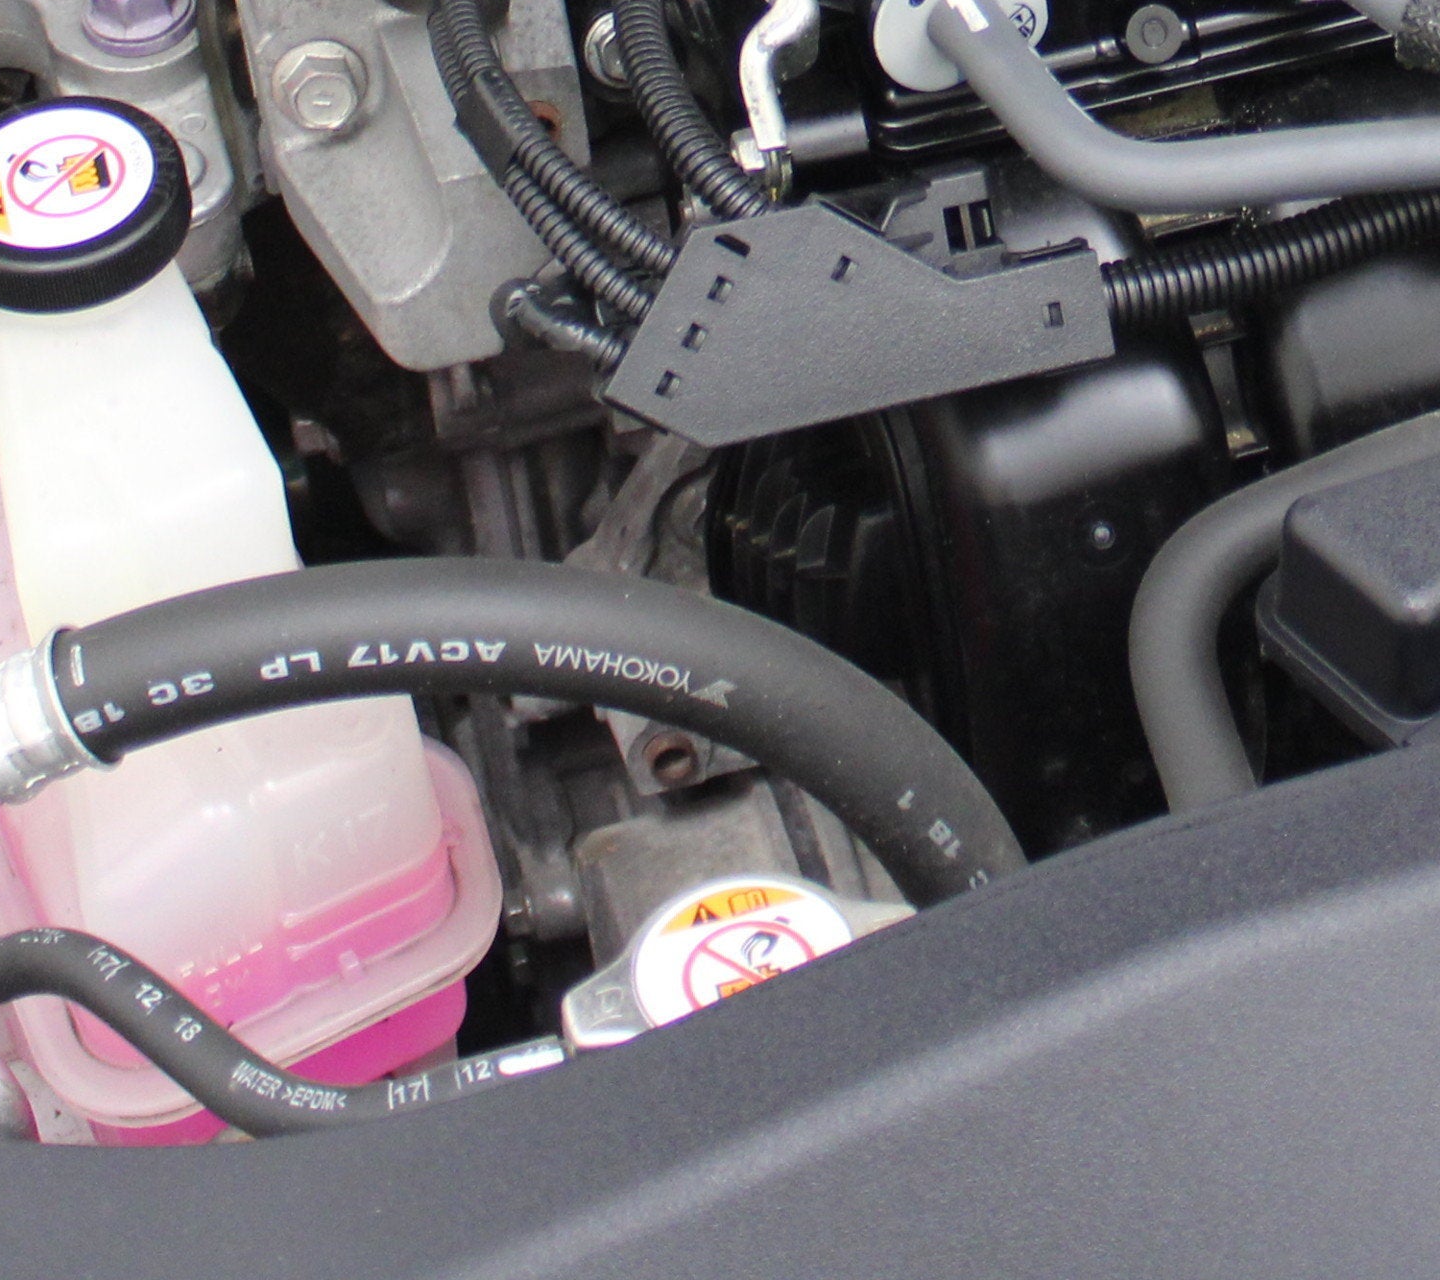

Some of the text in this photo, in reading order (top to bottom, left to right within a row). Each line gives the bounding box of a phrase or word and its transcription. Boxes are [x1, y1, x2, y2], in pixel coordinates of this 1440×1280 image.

[260, 648, 322, 681] LP
[347, 639, 507, 669] ACV17
[534, 642, 691, 693] YOKOHAMA
[147, 671, 216, 707] 3C
[135, 981, 164, 1009] 12
[174, 1016, 203, 1042] 18
[230, 1060, 282, 1100] WATER
[461, 1060, 492, 1084] 12
